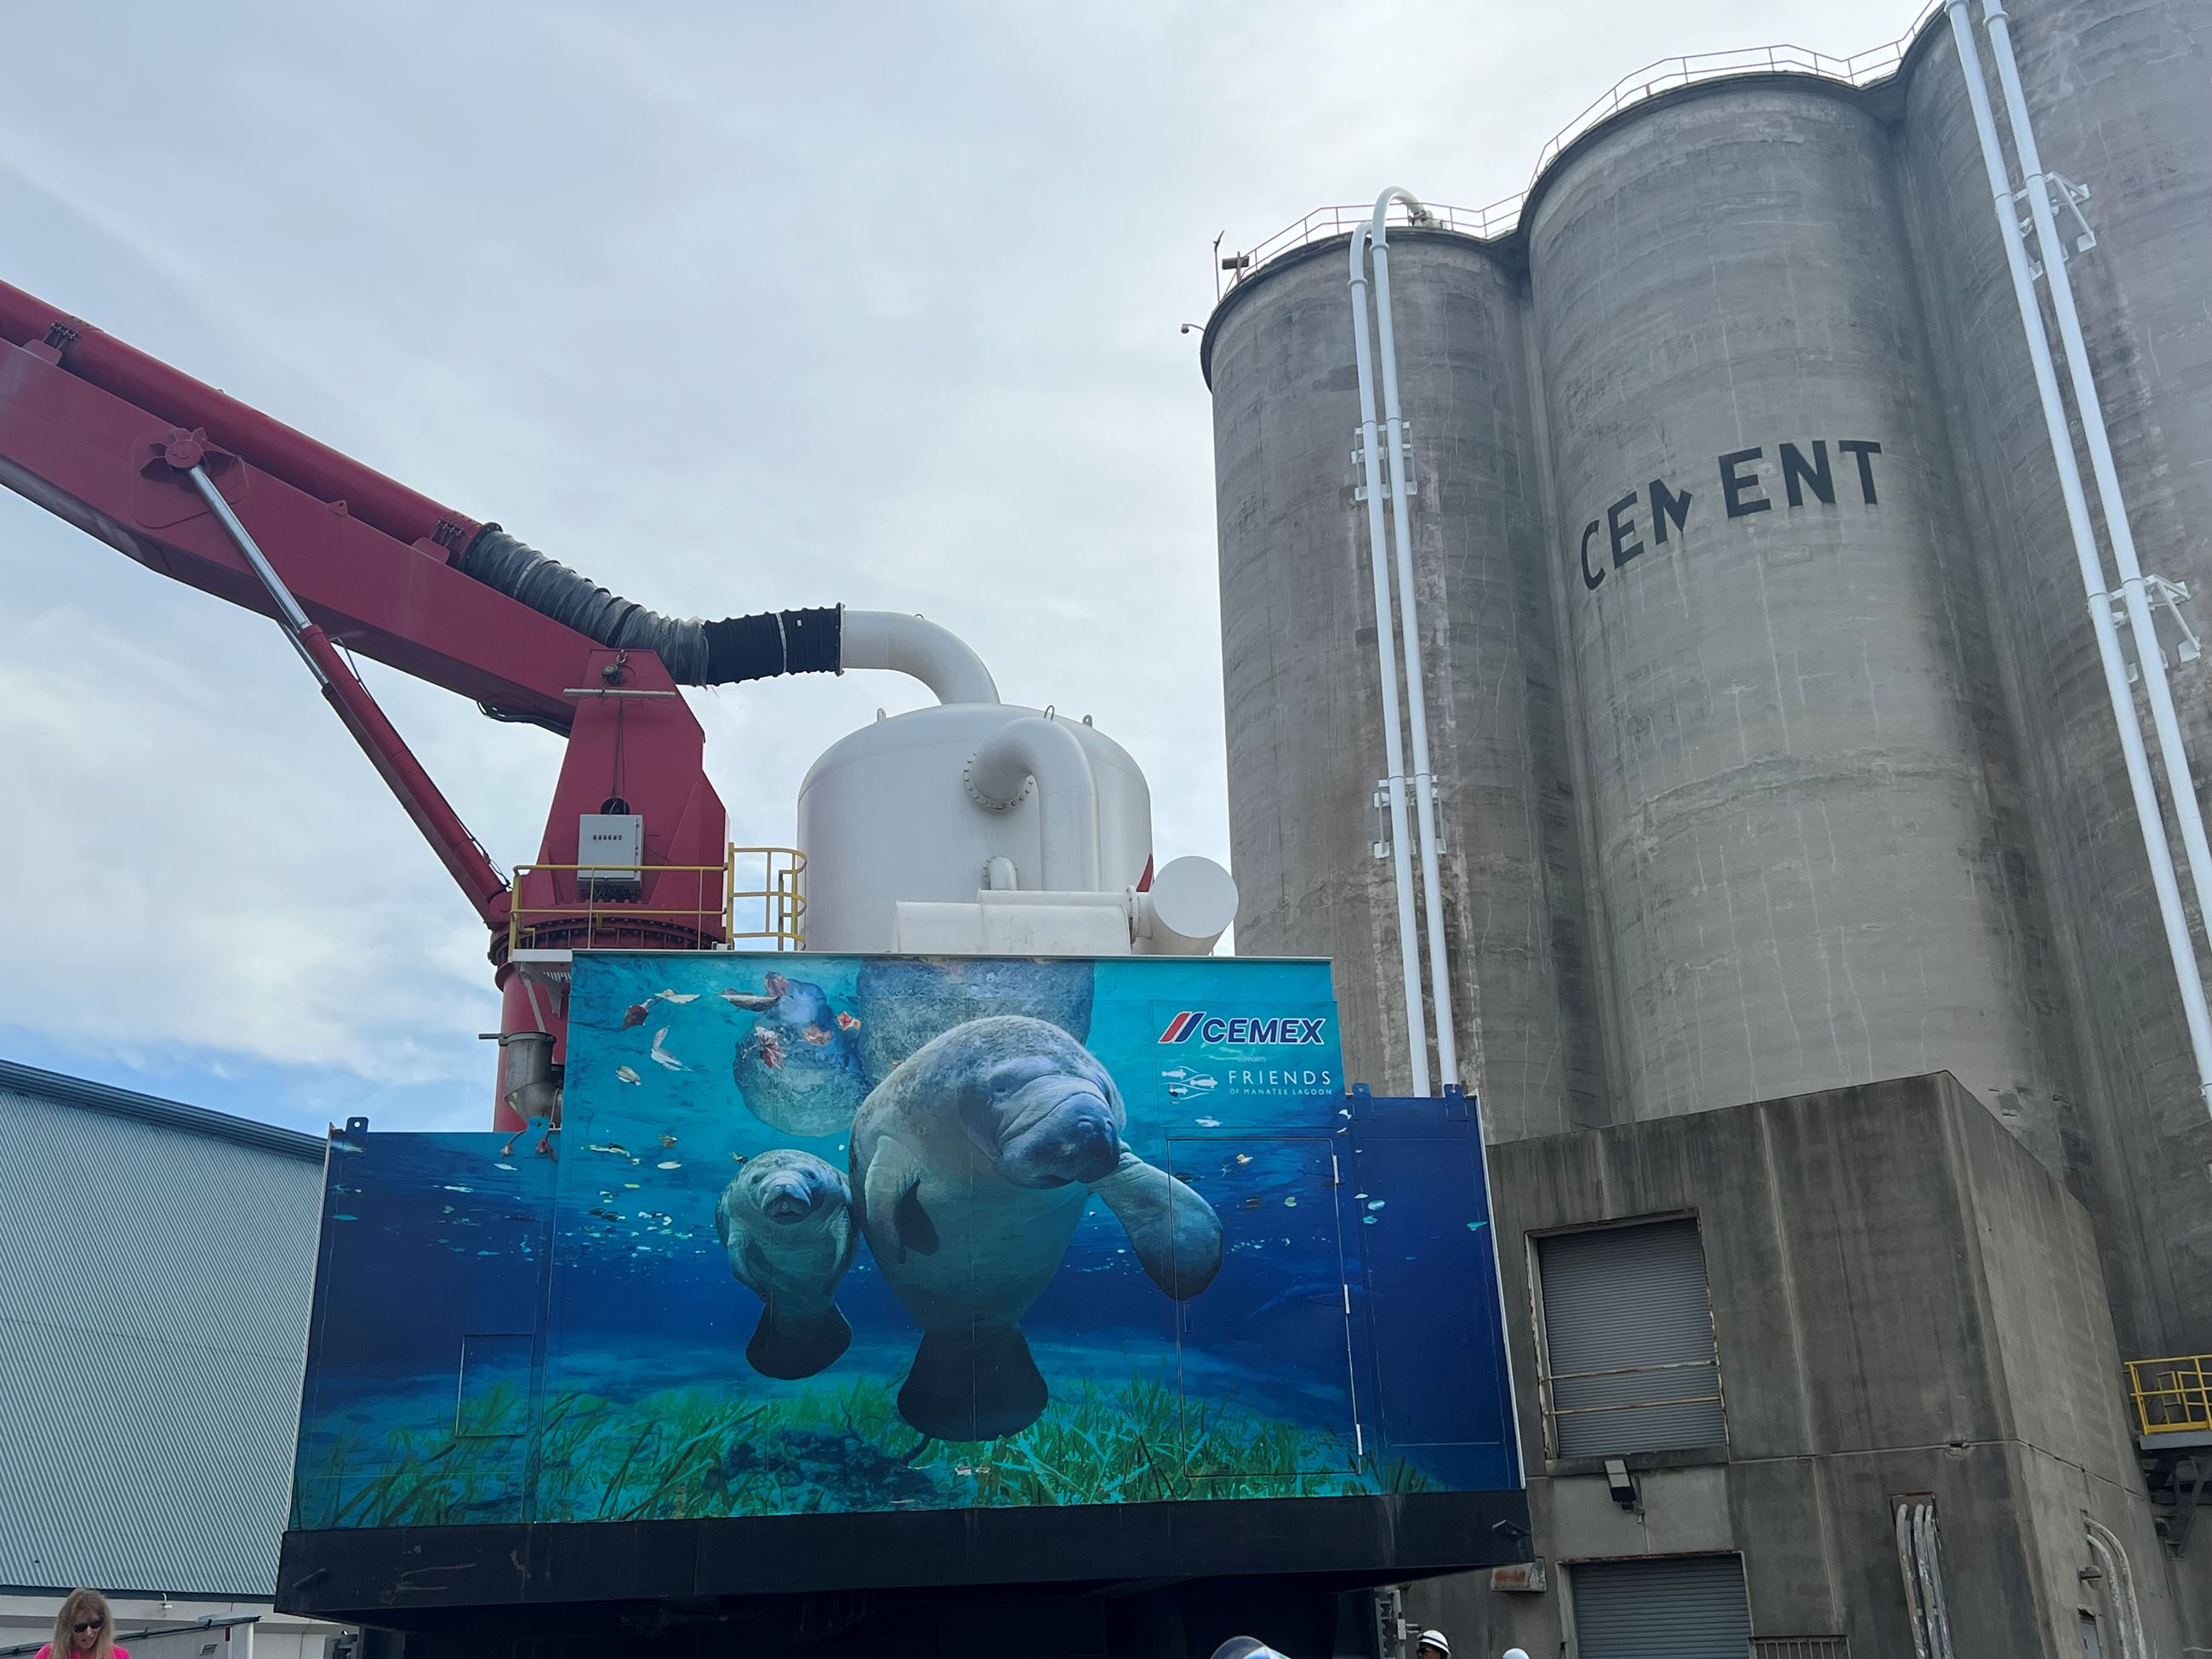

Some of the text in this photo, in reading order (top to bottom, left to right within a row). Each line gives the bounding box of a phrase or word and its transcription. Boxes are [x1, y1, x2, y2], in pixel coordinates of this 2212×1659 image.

[1201, 1018, 1326, 1046] CEMEX
[1237, 1055, 1267, 1063] SUPPORTS
[1228, 1069, 1331, 1086] FRIENDS
[1292, 1088, 1333, 1097] LAGOON
